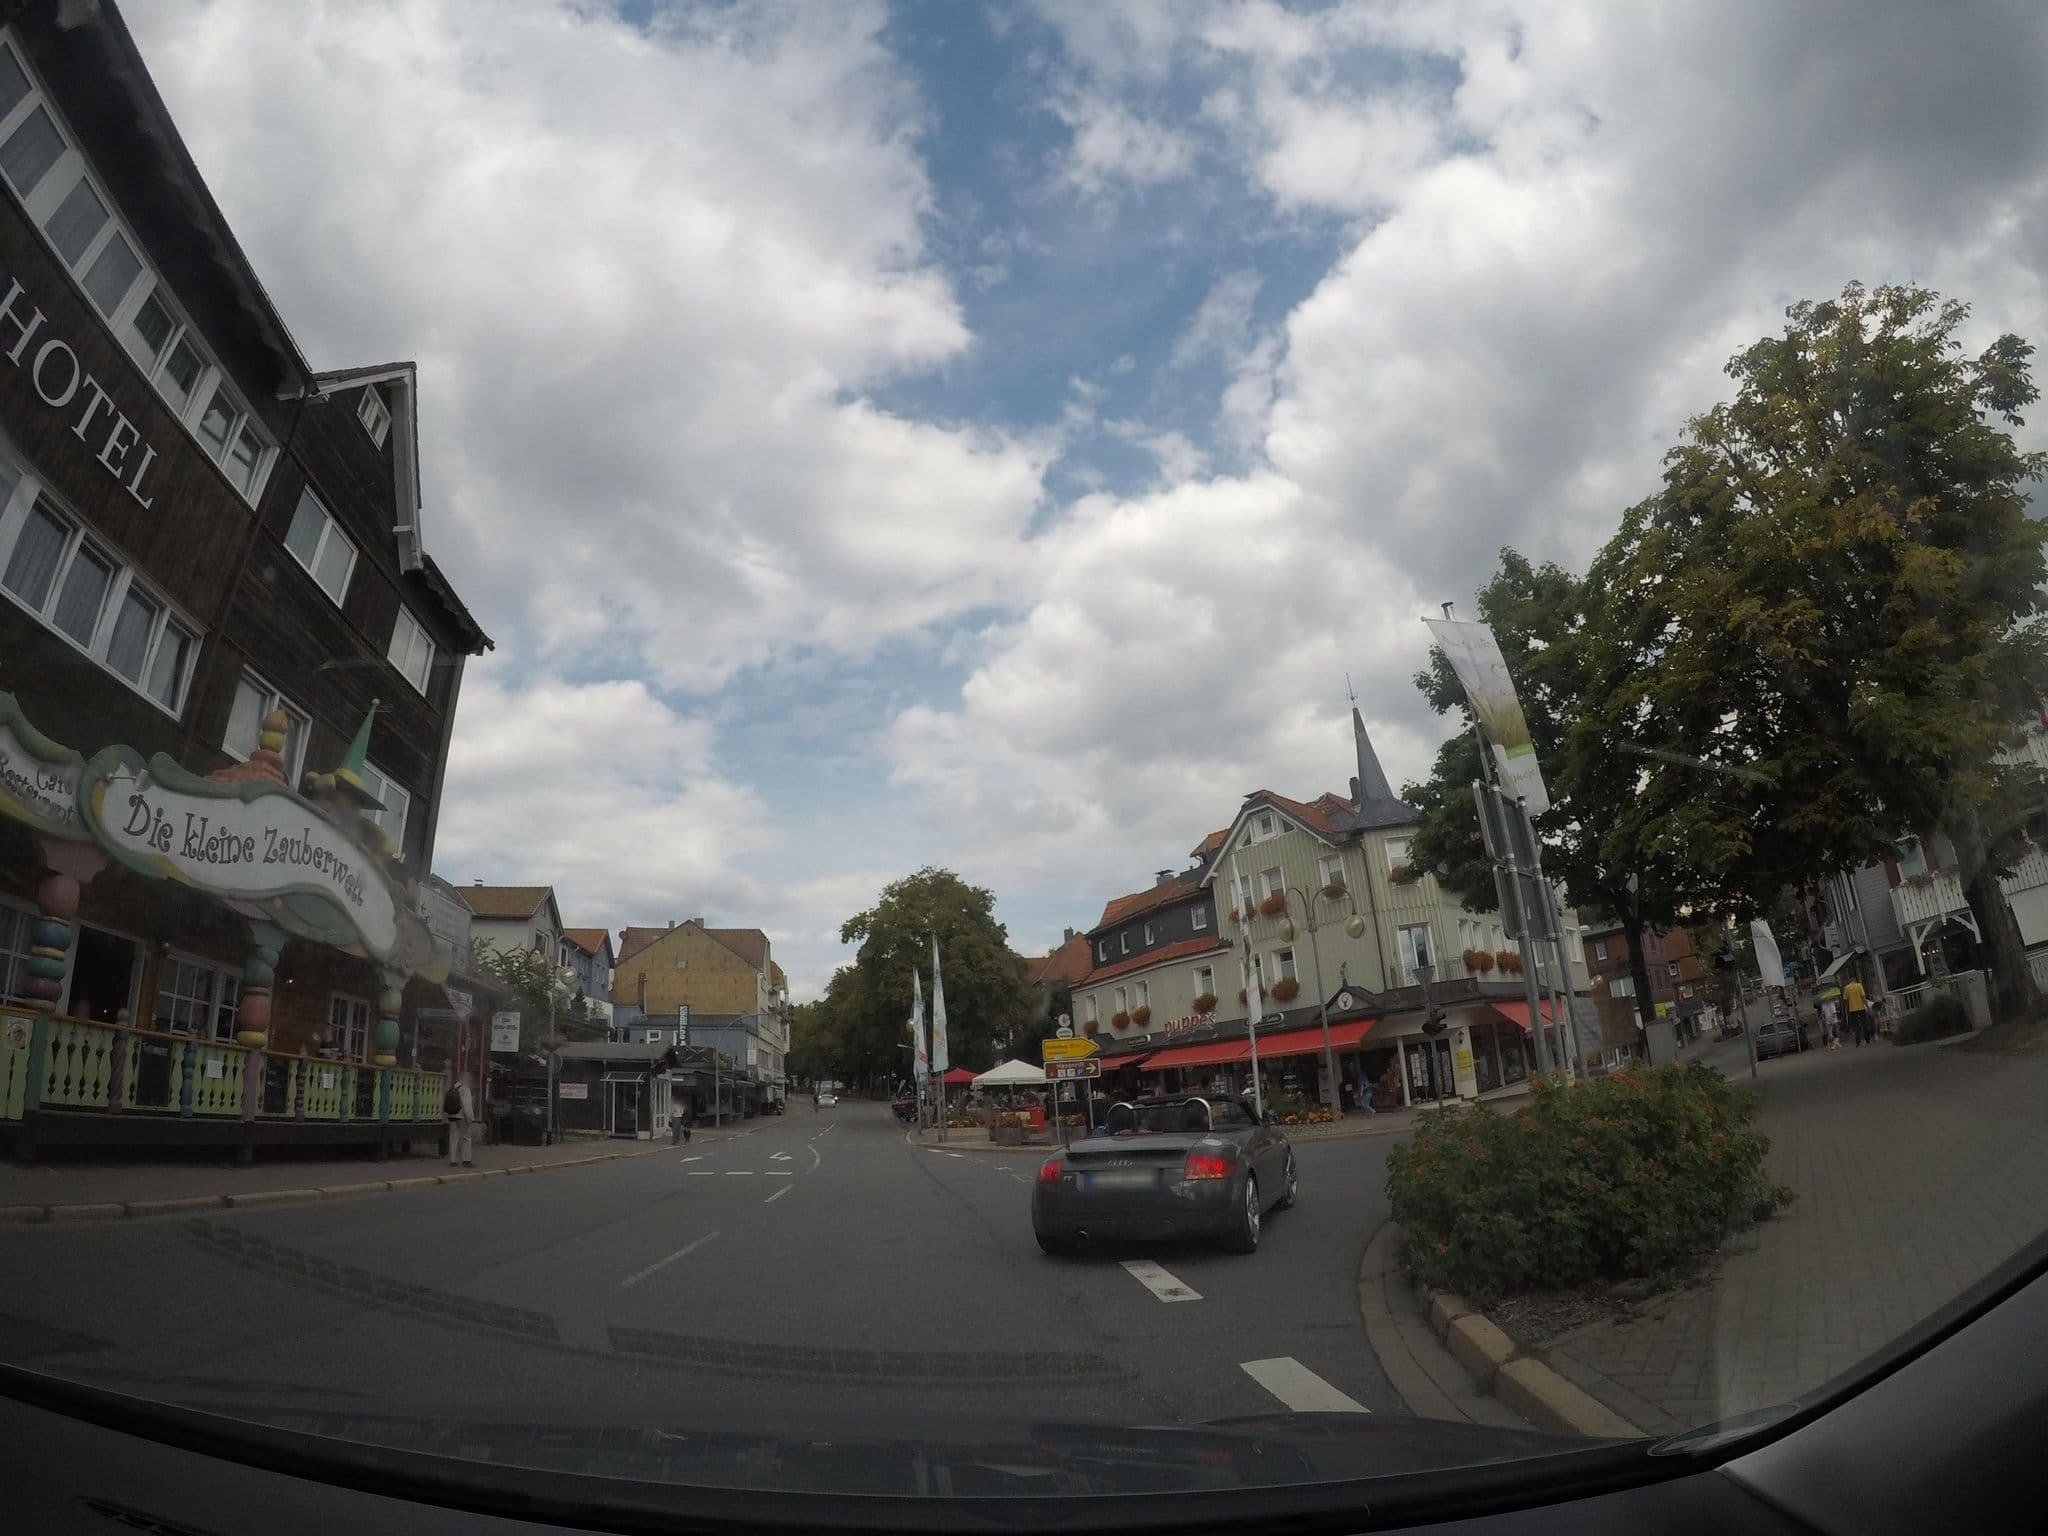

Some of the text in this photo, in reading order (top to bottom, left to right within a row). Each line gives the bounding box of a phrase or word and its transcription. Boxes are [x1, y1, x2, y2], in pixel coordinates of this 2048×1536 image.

[0, 277, 157, 510] HOTEL
[123, 794, 364, 907] Die kleine Zauberwelt
